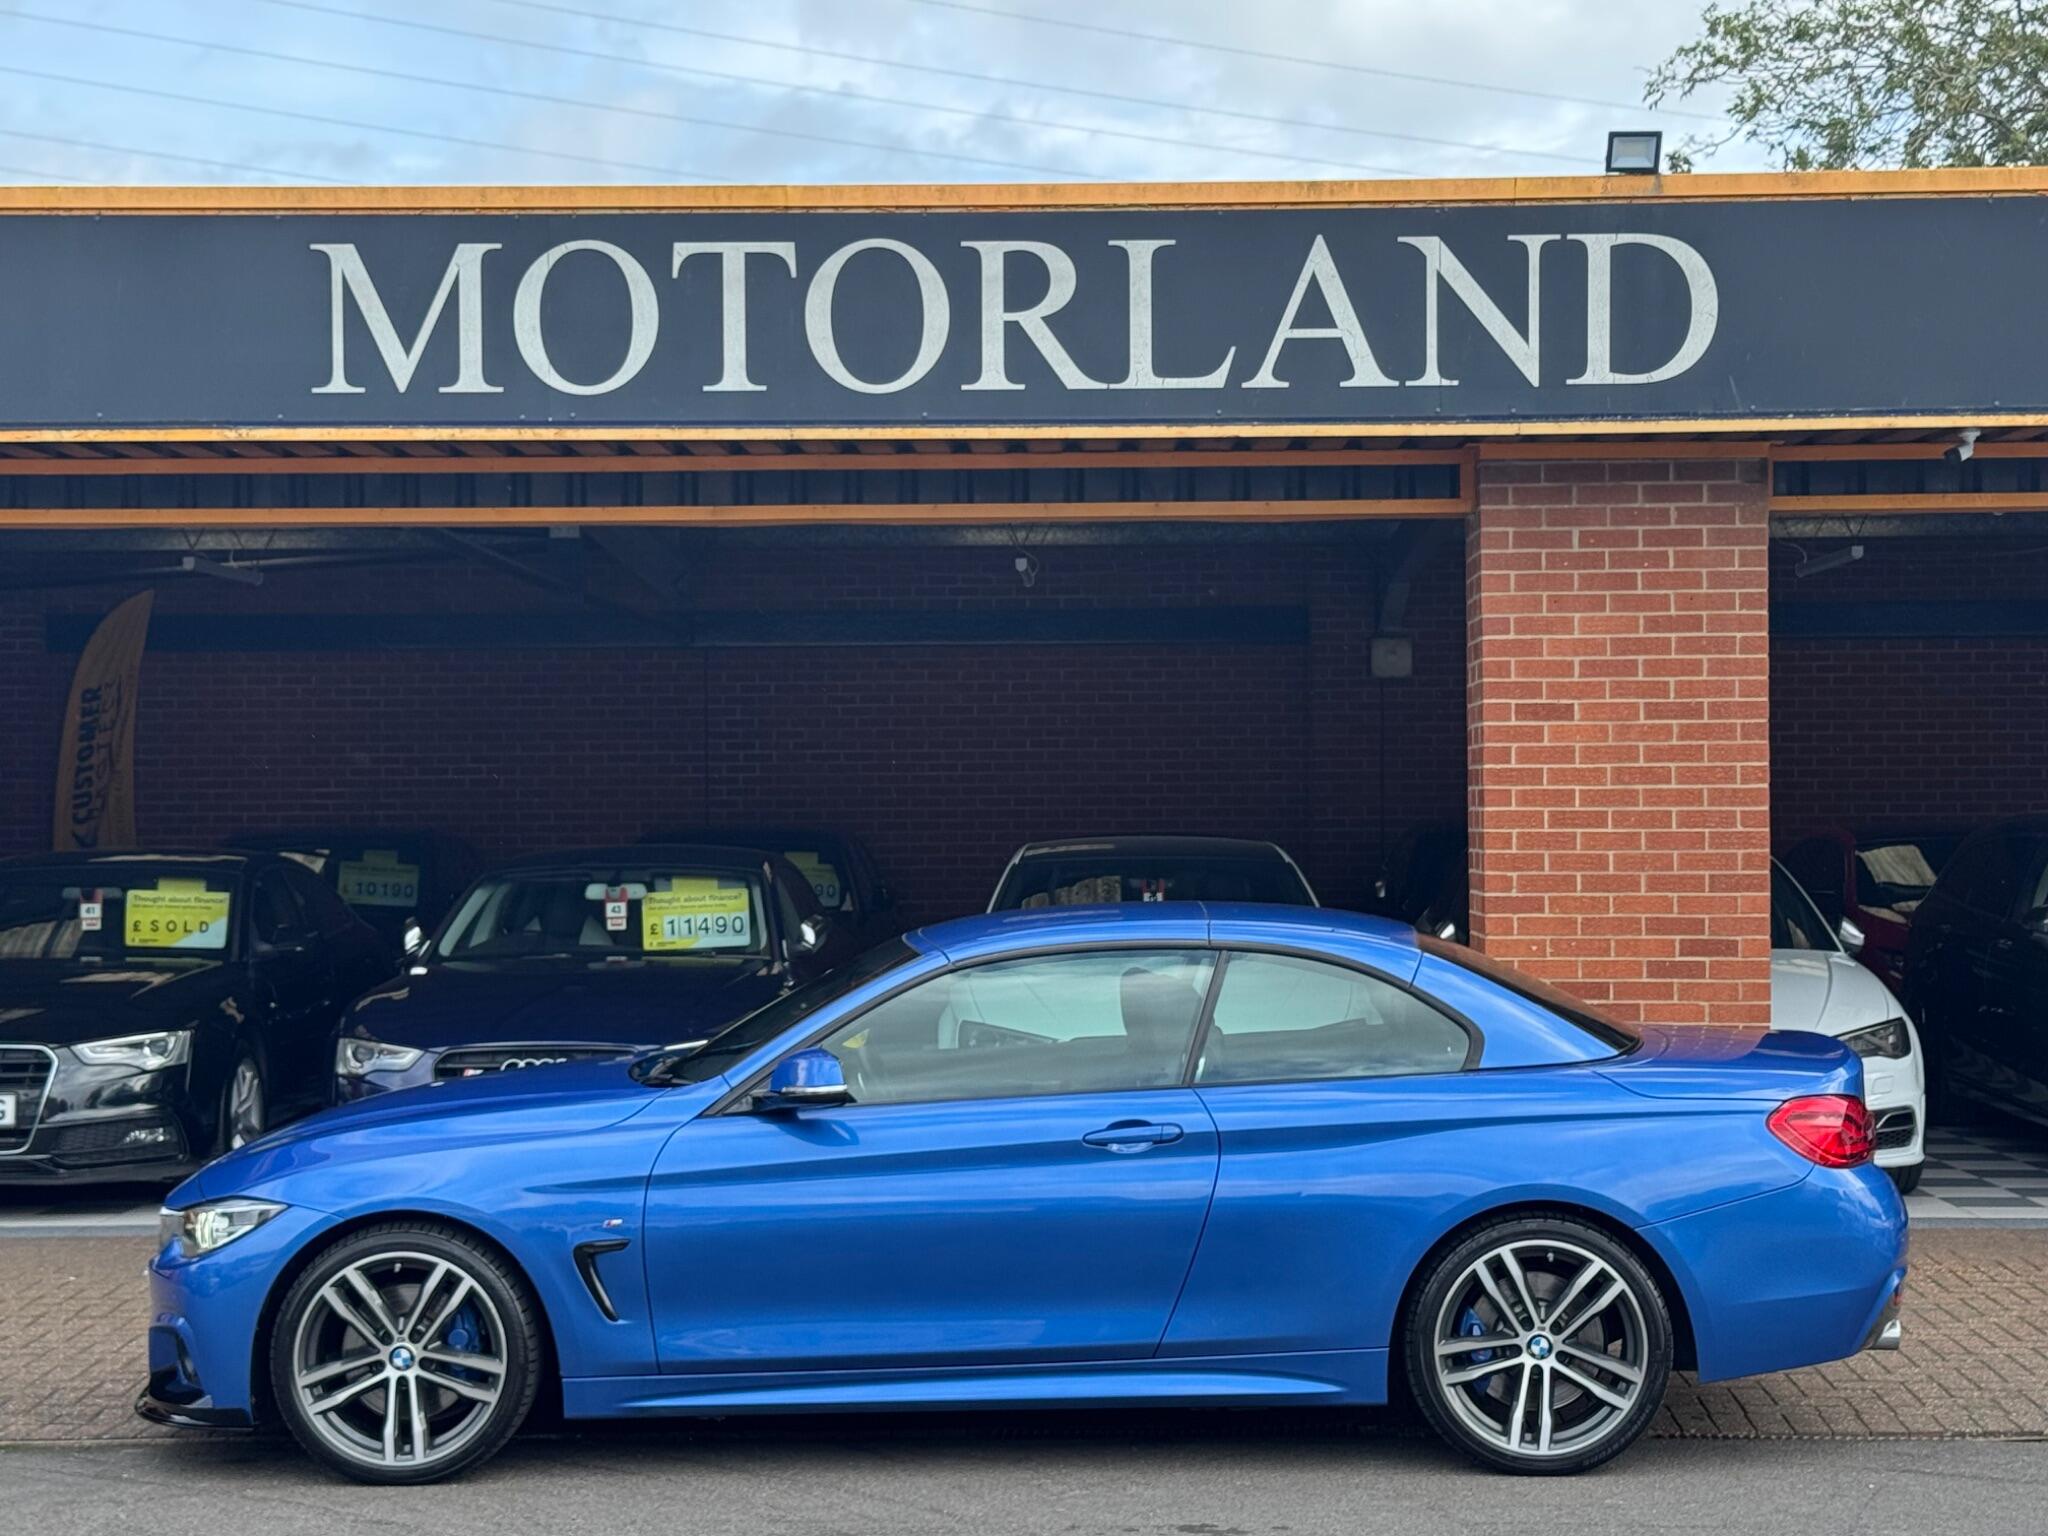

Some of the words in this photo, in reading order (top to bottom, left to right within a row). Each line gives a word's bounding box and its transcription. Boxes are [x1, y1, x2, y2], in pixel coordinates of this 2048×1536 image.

[308, 231, 1719, 396] MOTORLAND
[71, 684, 102, 826] CUSTOMER
[667, 915, 744, 937] 11490
